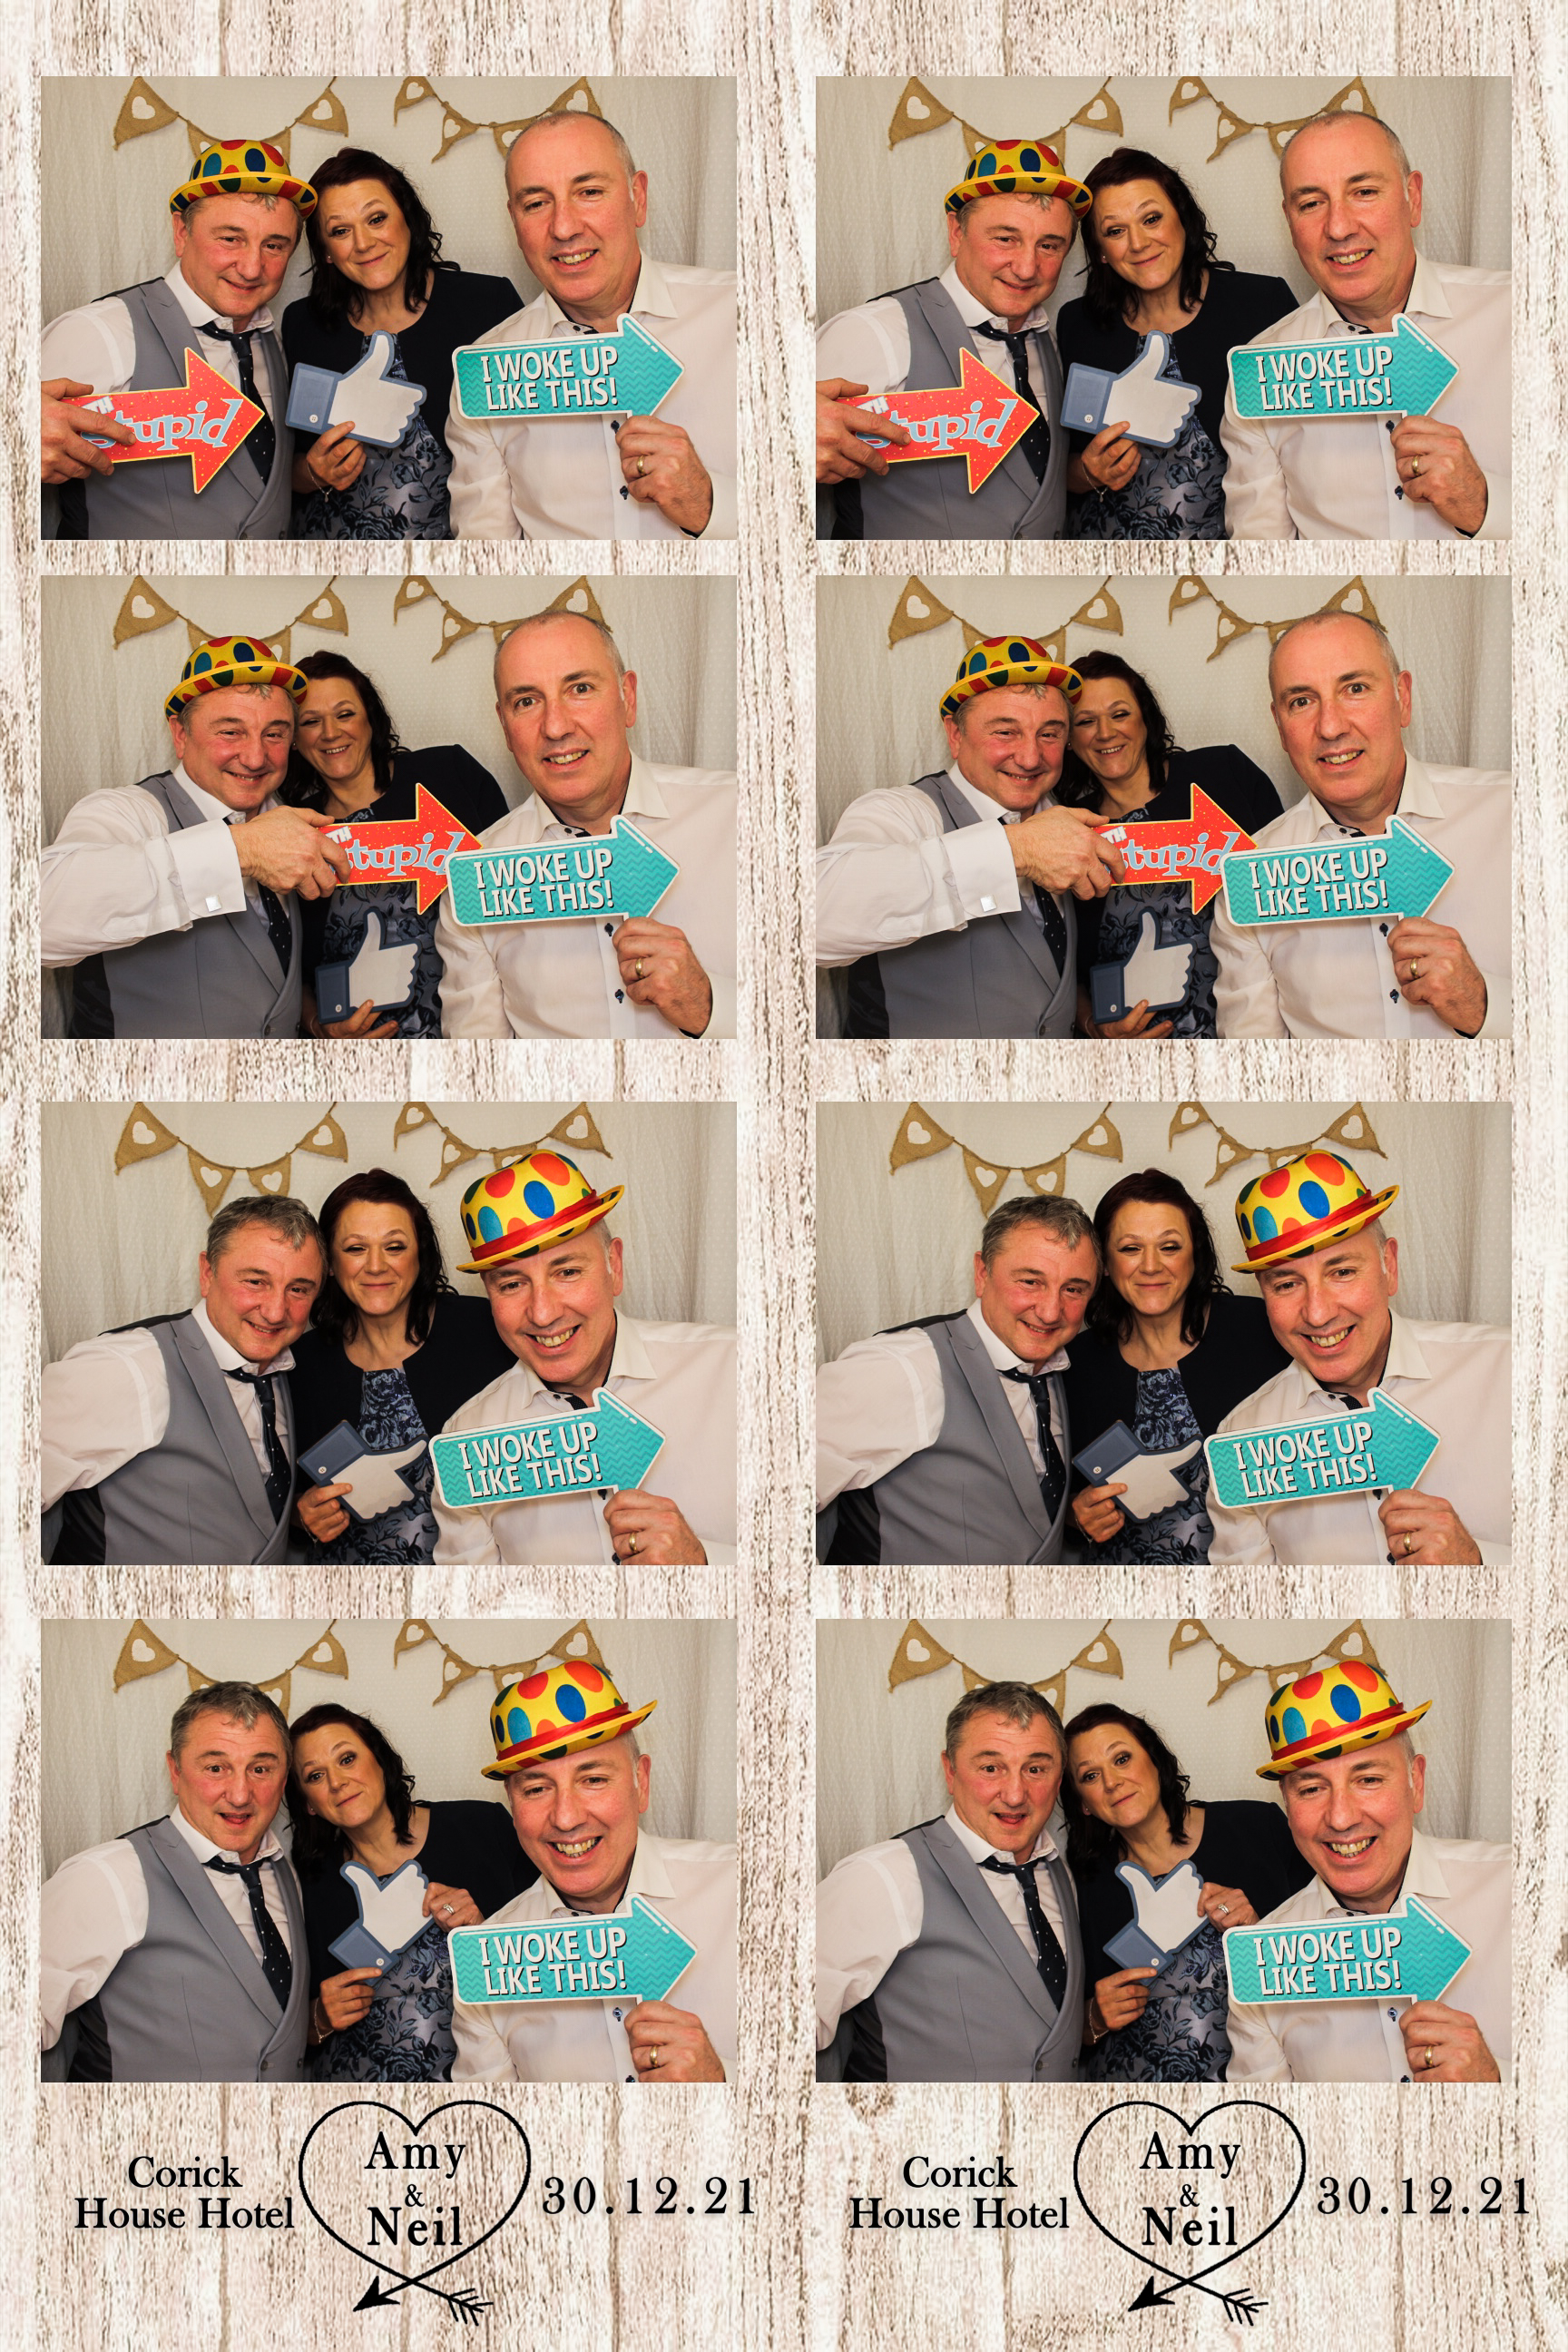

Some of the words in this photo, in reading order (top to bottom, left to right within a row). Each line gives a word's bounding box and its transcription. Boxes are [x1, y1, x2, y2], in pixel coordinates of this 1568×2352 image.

[481, 356, 492, 383] I
[494, 349, 575, 382] WOKE
[581, 346, 618, 377] UP
[1256, 356, 1267, 383] I
[1269, 349, 1350, 382] WOKE
[1356, 346, 1393, 377] UP
[485, 383, 540, 411] LIKE
[544, 377, 618, 407] THIS!
[1260, 383, 1315, 411] LIKE
[1319, 377, 1393, 407] THIS!
[330, 831, 466, 877] tupid
[474, 862, 485, 889] I
[487, 853, 570, 887] WOKE
[574, 848, 612, 878] UP
[1105, 831, 1240, 877] tupid
[1249, 862, 1260, 889] I
[1262, 853, 1345, 887] WOKE
[1349, 848, 1387, 878] UP
[480, 887, 534, 917] LIKE
[540, 879, 614, 912] THIS!
[1255, 887, 1309, 917] LIKE
[1315, 879, 1389, 912] THIS!
[458, 1443, 472, 1470] I
[472, 1428, 556, 1468] WOKE
[558, 1422, 598, 1455] UP
[1233, 1443, 1247, 1470] I
[1247, 1428, 1331, 1468] WOKE
[1333, 1422, 1373, 1455] UP
[466, 1465, 524, 1498] LIKE
[526, 1453, 603, 1489] THIS!
[1241, 1465, 1298, 1498] LIKE
[1301, 1453, 1377, 1489] THIS!
[478, 1937, 491, 1966] I
[493, 1931, 581, 1965] WOKE
[586, 1926, 627, 1959] UP
[1253, 1937, 1266, 1966] I
[1268, 1931, 1356, 1965] WOKE
[1361, 1926, 1402, 1959] UP
[484, 1965, 543, 1996] LIKE
[548, 1960, 627, 1993] THIS!
[1259, 1965, 1318, 1996] LIKE
[1323, 1960, 1402, 1993] THIS!
